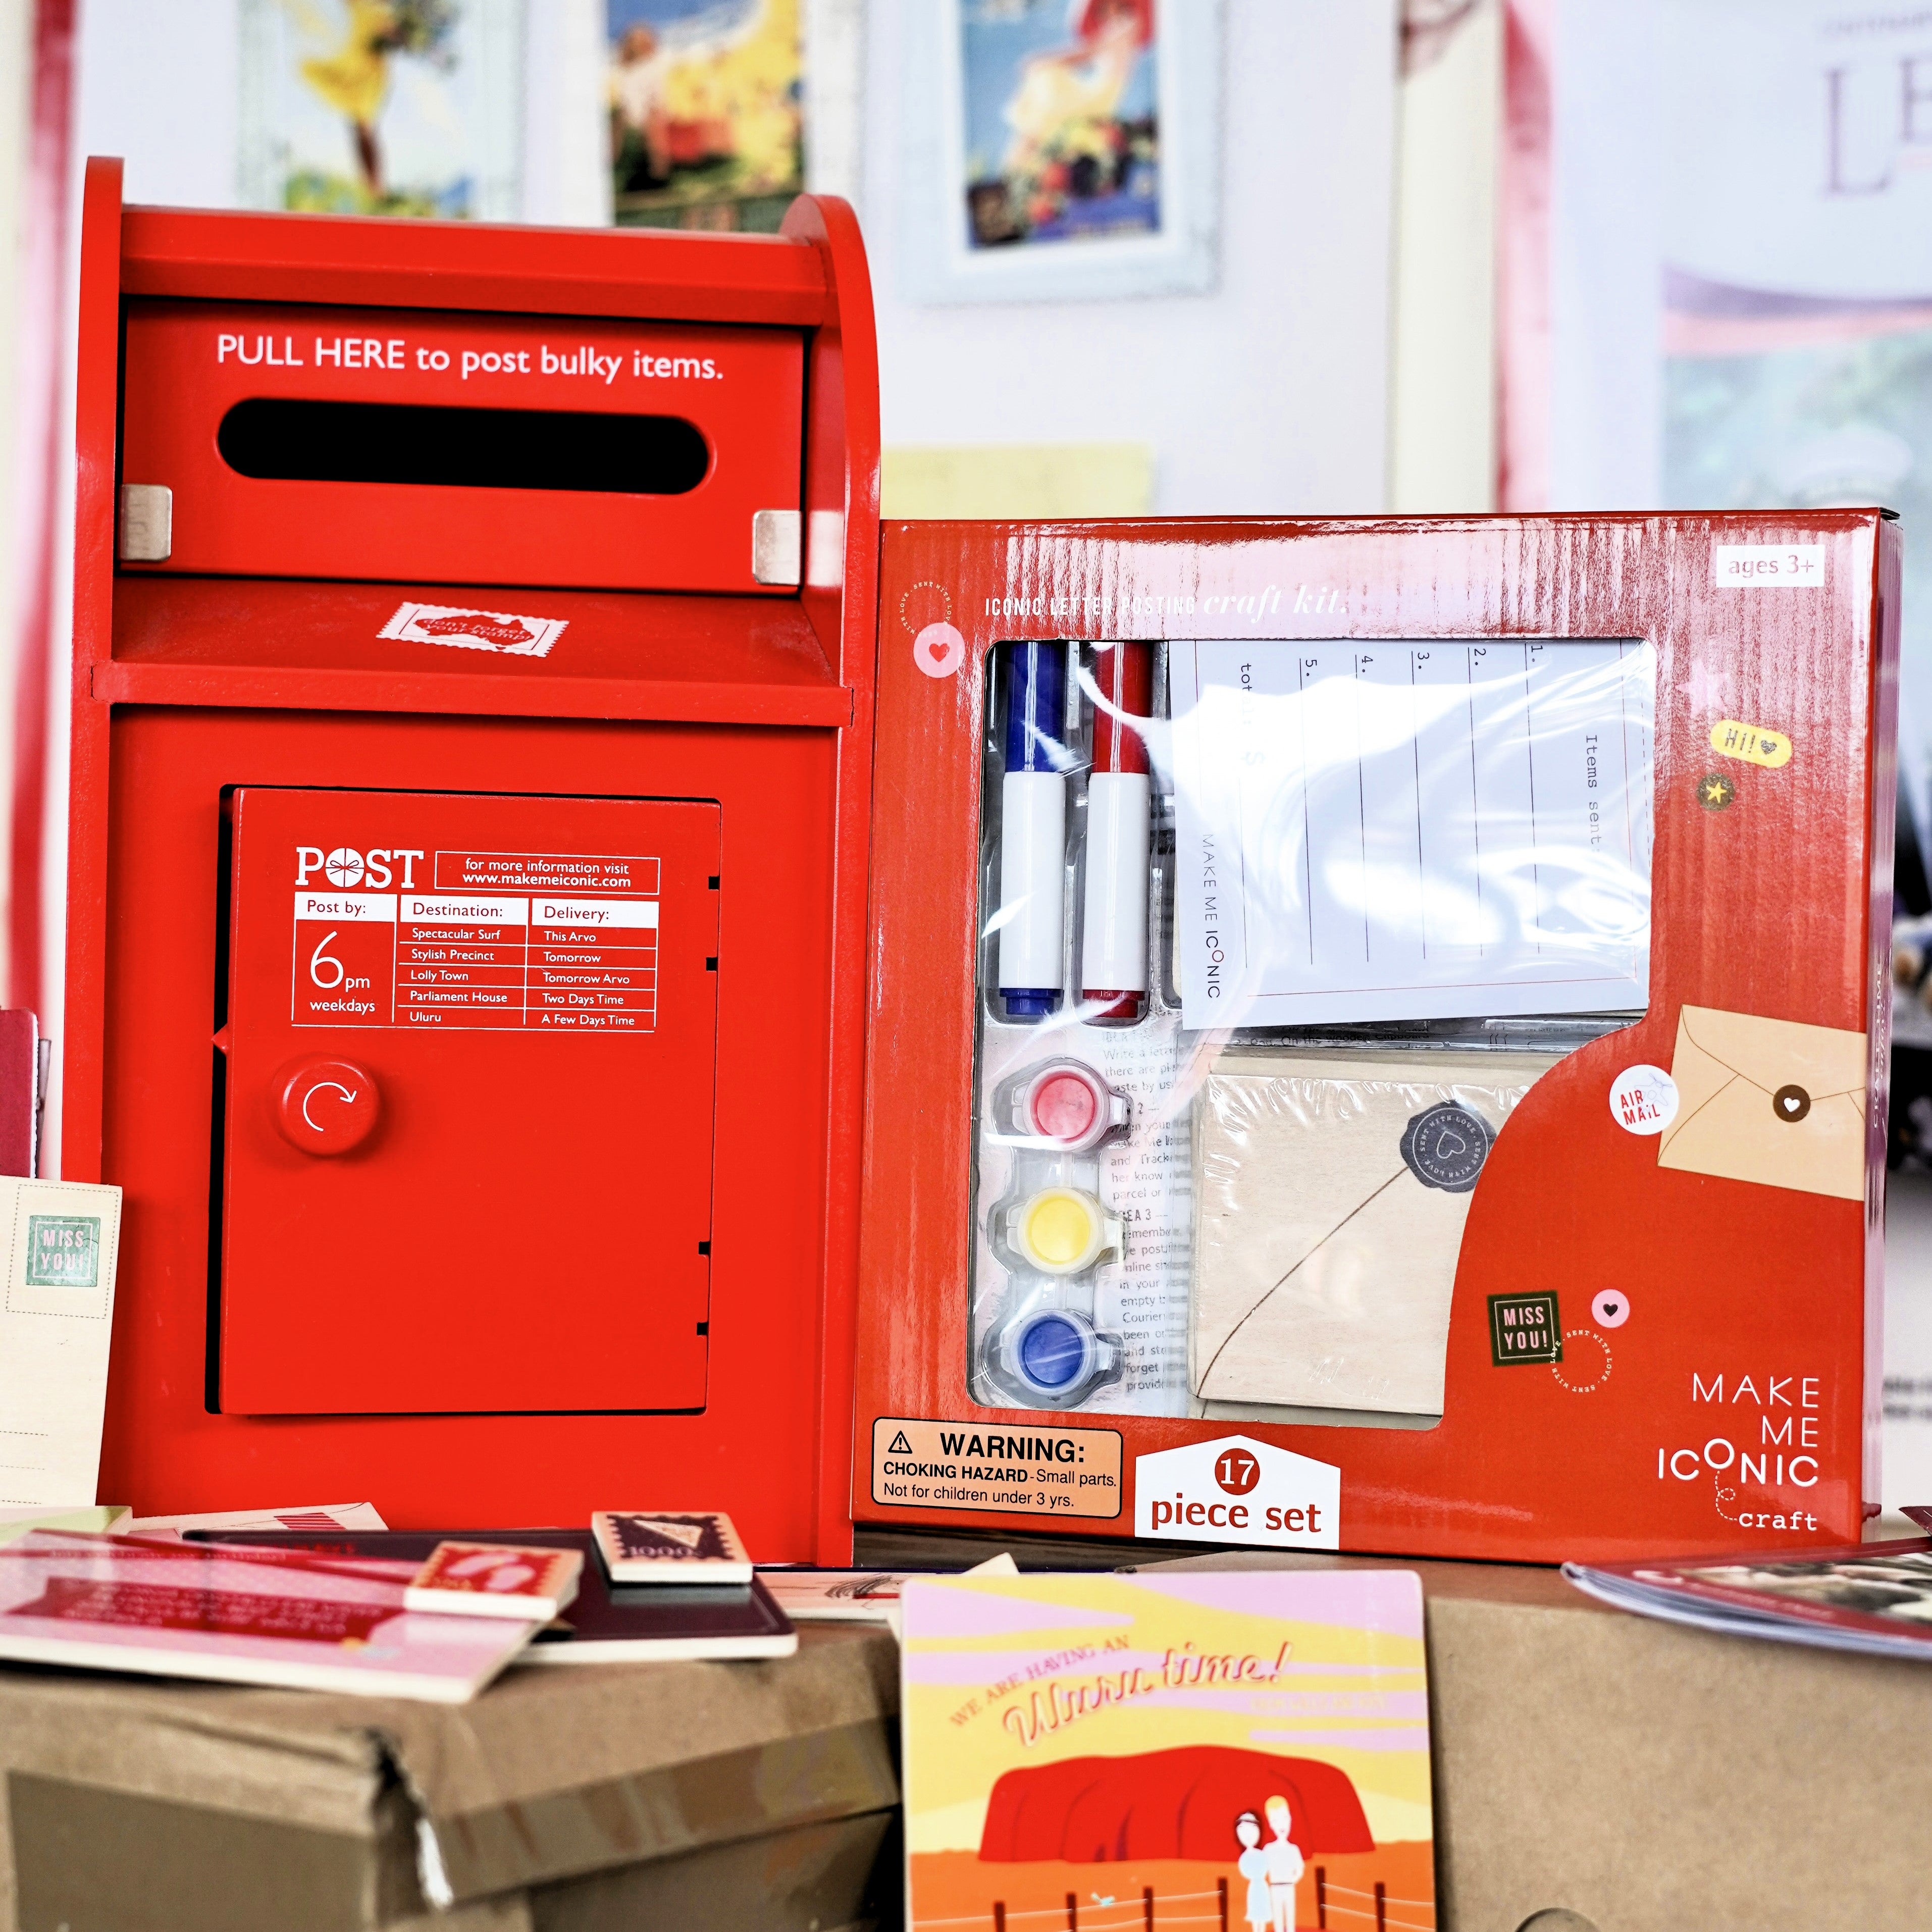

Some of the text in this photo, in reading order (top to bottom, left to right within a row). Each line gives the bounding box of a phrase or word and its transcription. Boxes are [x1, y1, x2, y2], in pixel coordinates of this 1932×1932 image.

[218, 334, 723, 384] PULL HERE to post bulky items.
[1728, 554, 1814, 578] ages 3+
[913, 581, 933, 590] SENT
[935, 584, 951, 602] WITH
[985, 584, 1348, 624] ICONIC LETTER POSTING craft kit.
[1361, 655, 1374, 672] 4.
[1417, 651, 1430, 669] 3.
[1474, 648, 1486, 665] 2.
[1306, 659, 1317, 676] 5.
[1586, 735, 1597, 788] Items
[295, 846, 425, 889] POST
[465, 858, 630, 875] for more information visit
[462, 872, 632, 888] www.makemeiconic.com
[307, 900, 366, 917] Post by:
[412, 902, 503, 918] Destination:
[544, 906, 609, 923] Delivery:
[1202, 833, 1224, 999] MAKE ME ICONIC
[411, 927, 501, 942] Spectacular Surf
[544, 930, 597, 943] This Arvo
[411, 949, 494, 962] Stylish Precinct
[544, 952, 601, 963] Tomorrow
[410, 970, 469, 983] Lolly Town
[543, 972, 630, 984] Tomorrow Arvo
[410, 990, 508, 1003] Parliament House
[542, 993, 624, 1006] Two Days Time
[309, 1000, 375, 1016] weekdays
[409, 1011, 442, 1022] Uluru
[542, 1015, 635, 1028] A Few Days Time
[1105, 1066, 1133, 1077] there
[1621, 1089, 1643, 1109] AIR
[1134, 1171, 1163, 1181] know
[1113, 1187, 1147, 1203] parcel
[43, 1228, 84, 1247] MISS
[41, 1252, 84, 1271] YOU!
[1125, 1261, 1152, 1272] nline
[1136, 1279, 1160, 1291] your
[1120, 1295, 1156, 1308] empty
[1503, 1306, 1544, 1326] MISS
[1123, 1330, 1150, 1340] been
[1504, 1330, 1547, 1350] YOU!
[1124, 1345, 1144, 1356] and
[1126, 1362, 1159, 1375] forget
[1550, 1329, 1613, 1393] SENT WITH LOVE SENT WITH LOVE
[1692, 1372, 1819, 1408] MAKE
[1761, 1415, 1818, 1448] ME
[940, 1432, 1085, 1463] WARNING:
[1658, 1437, 1819, 1488] ICONIC
[883, 1461, 957, 1479] CHOKING
[1079, 1473, 1117, 1488] parts.
[1220, 1457, 1255, 1486] 17
[884, 1482, 1075, 1509] Not for children under 3 yrs.
[1152, 1492, 1322, 1533] piece set
[1738, 1510, 1818, 1532] craft
[1163, 1641, 1294, 1688] time!
[950, 1635, 1131, 1728] WE ARE HAVING AN
